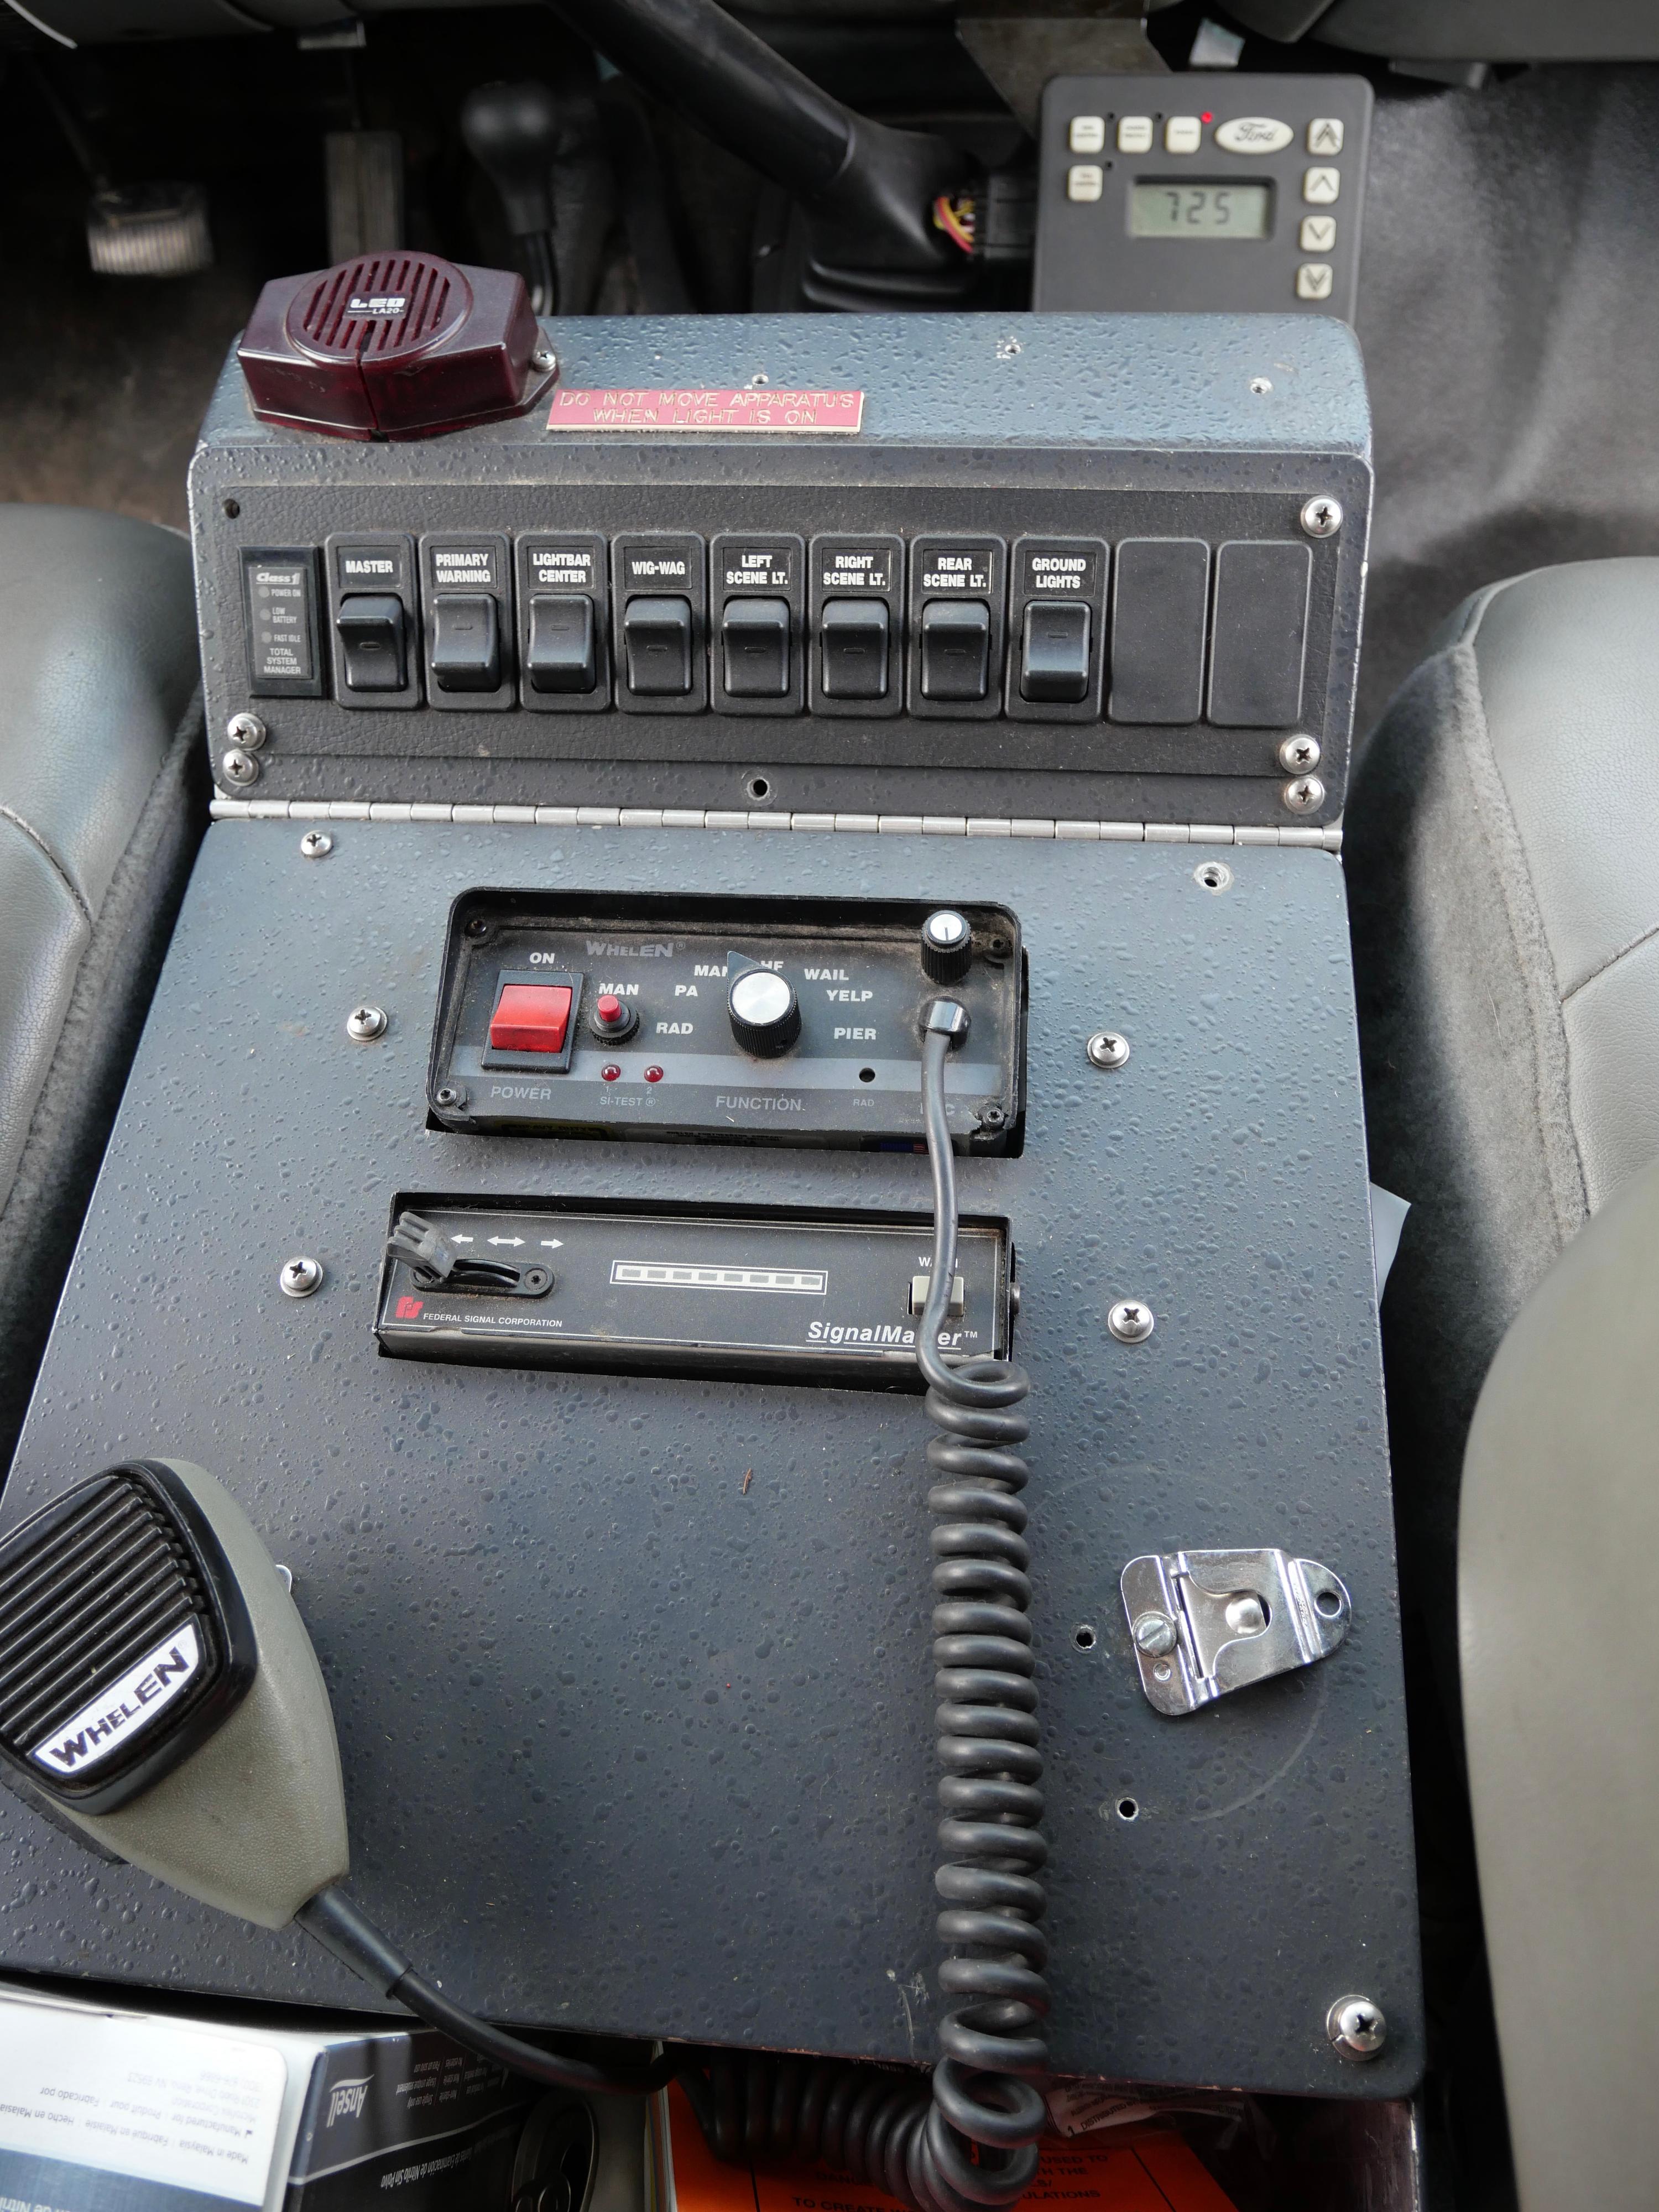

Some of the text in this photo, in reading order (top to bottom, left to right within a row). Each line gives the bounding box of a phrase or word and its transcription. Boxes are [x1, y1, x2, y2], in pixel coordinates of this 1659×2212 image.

[1234, 122, 1275, 142] Ford
[1166, 192, 1230, 225] 725
[349, 298, 406, 309] LED
[559, 392, 854, 408] DO NOT MOVE APPARATUS
[593, 408, 817, 425] WHEN LIGHT IS ON
[345, 560, 394, 573] MASTER
[435, 554, 488, 566] PRIMARY
[533, 554, 591, 567] LIGHTBAR
[742, 555, 773, 568] LEFT
[835, 556, 874, 569] RIGHT
[937, 557, 973, 571] REAR
[1032, 557, 1087, 572] GROUND
[632, 561, 686, 576] WIG-WAG
[436, 570, 492, 583] WARNING
[538, 570, 587, 583] CENTER
[726, 571, 789, 585] SCENE LT.
[823, 572, 886, 586] SCENE LT.
[923, 574, 987, 588] SCENE LT.
[1036, 575, 1081, 589] LIGHTS
[270, 588, 301, 597] POWER ON
[272, 607, 286, 615] LOW
[272, 615, 298, 624] BATTERY
[273, 634, 301, 643] FAST IDLE
[269, 647, 294, 656] TOTAL
[266, 656, 298, 666] SYSTEM
[263, 665, 301, 675] MANAGER
[529, 952, 555, 964] ON
[804, 968, 850, 981] WAIL
[598, 983, 639, 995] MAN
[674, 984, 698, 997] PA
[826, 989, 874, 1003] YELP
[655, 1022, 693, 1035] RAD
[833, 1027, 877, 1041] PIER
[490, 1086, 552, 1100] POWER
[646, 1086, 653, 1094] 2
[599, 1096, 643, 1107] SI-TEST
[715, 1095, 802, 1112] FUNCTION
[853, 1098, 875, 1108] RAD
[422, 1313, 563, 1327] FEDERAL SIGNAL CORPORATION
[49, 1646, 190, 1768] WHELEN
[39, 2086, 100, 2107] Fabricado por
[109, 2100, 162, 2120] Produit pour
[326, 2085, 368, 2128] Ansell
[0, 2103, 75, 2125] Hecho en Malasia
[86, 2119, 117, 2135] Malaisie
[120, 2127, 131, 2136] en
[172, 2114, 241, 2137] Manufactured for
[180, 2139, 248, 2164] Made in Malaysia
[1041, 2154, 1108, 2164] USED TO
[395, 2169, 404, 2185] Sin
[404, 2164, 420, 2183] Nitrilo
[420, 2162, 428, 2178] de
[380, 2172, 396, 2190] Polvo
[791, 2195, 816, 2208] TO
[1022, 2190, 1101, 2199] ULATIONS
